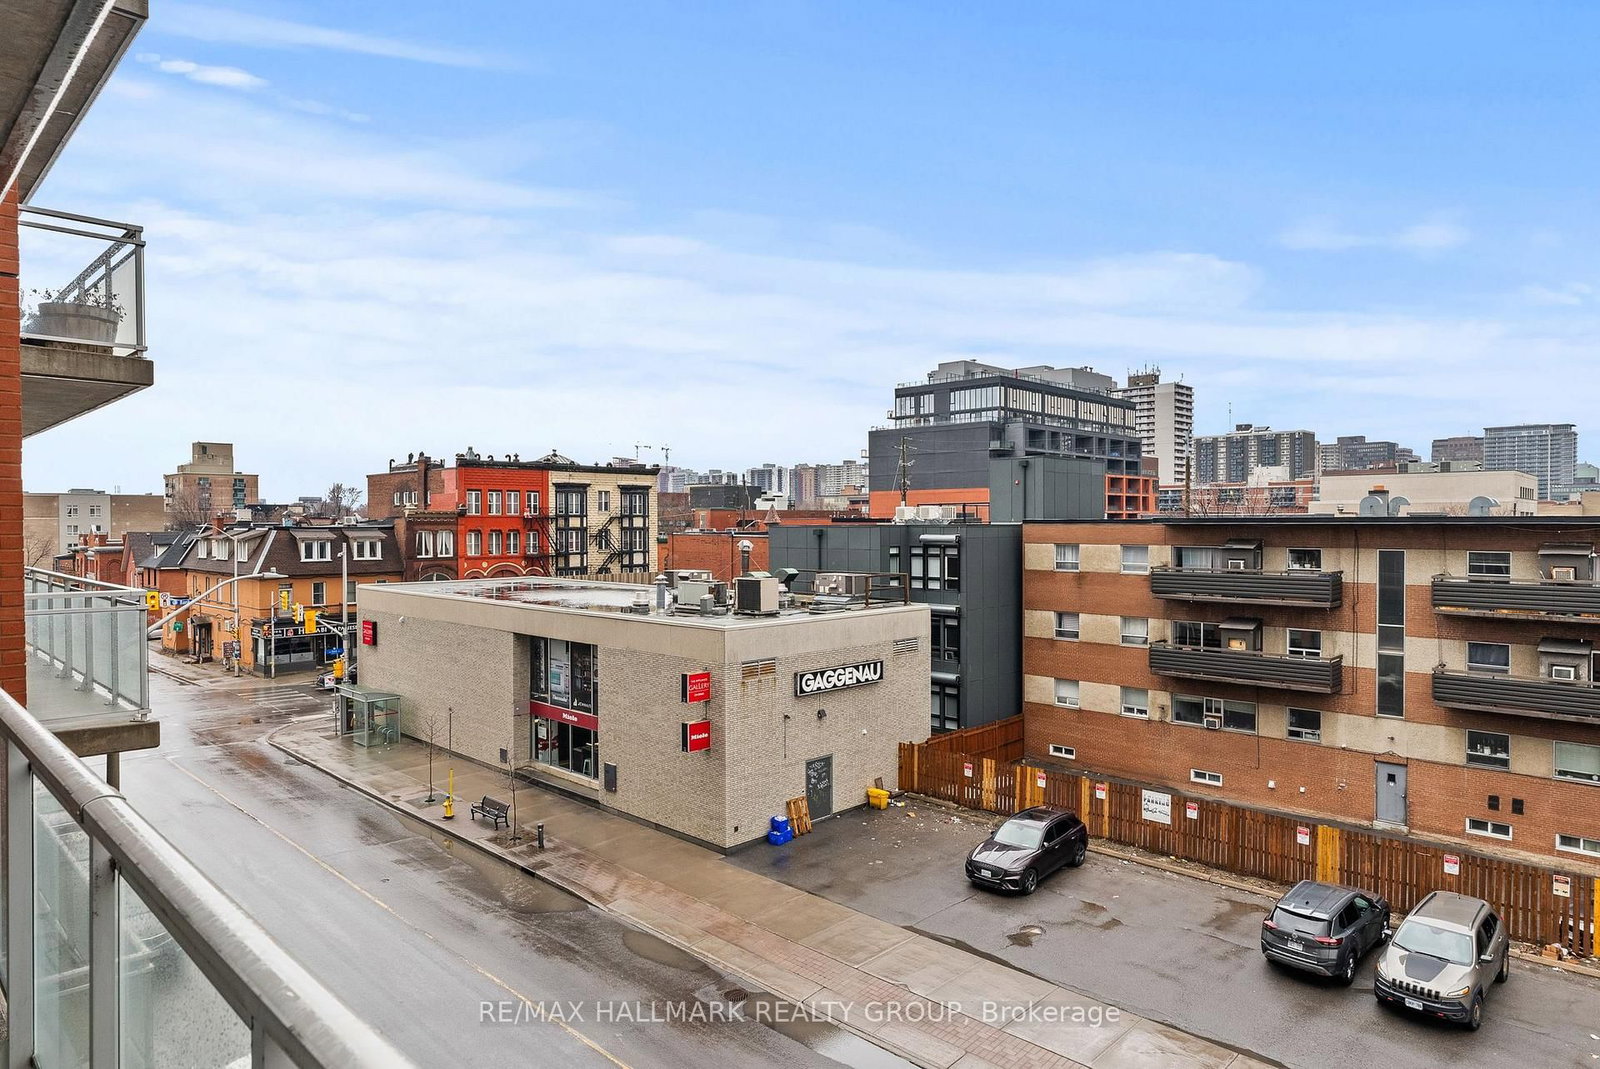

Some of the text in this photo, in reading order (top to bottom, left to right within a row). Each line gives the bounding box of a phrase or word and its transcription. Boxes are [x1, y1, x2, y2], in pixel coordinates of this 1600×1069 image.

[802, 662, 881, 692] GAGGENAU
[688, 682, 710, 691] GALLERY
[562, 712, 578, 722] Miele
